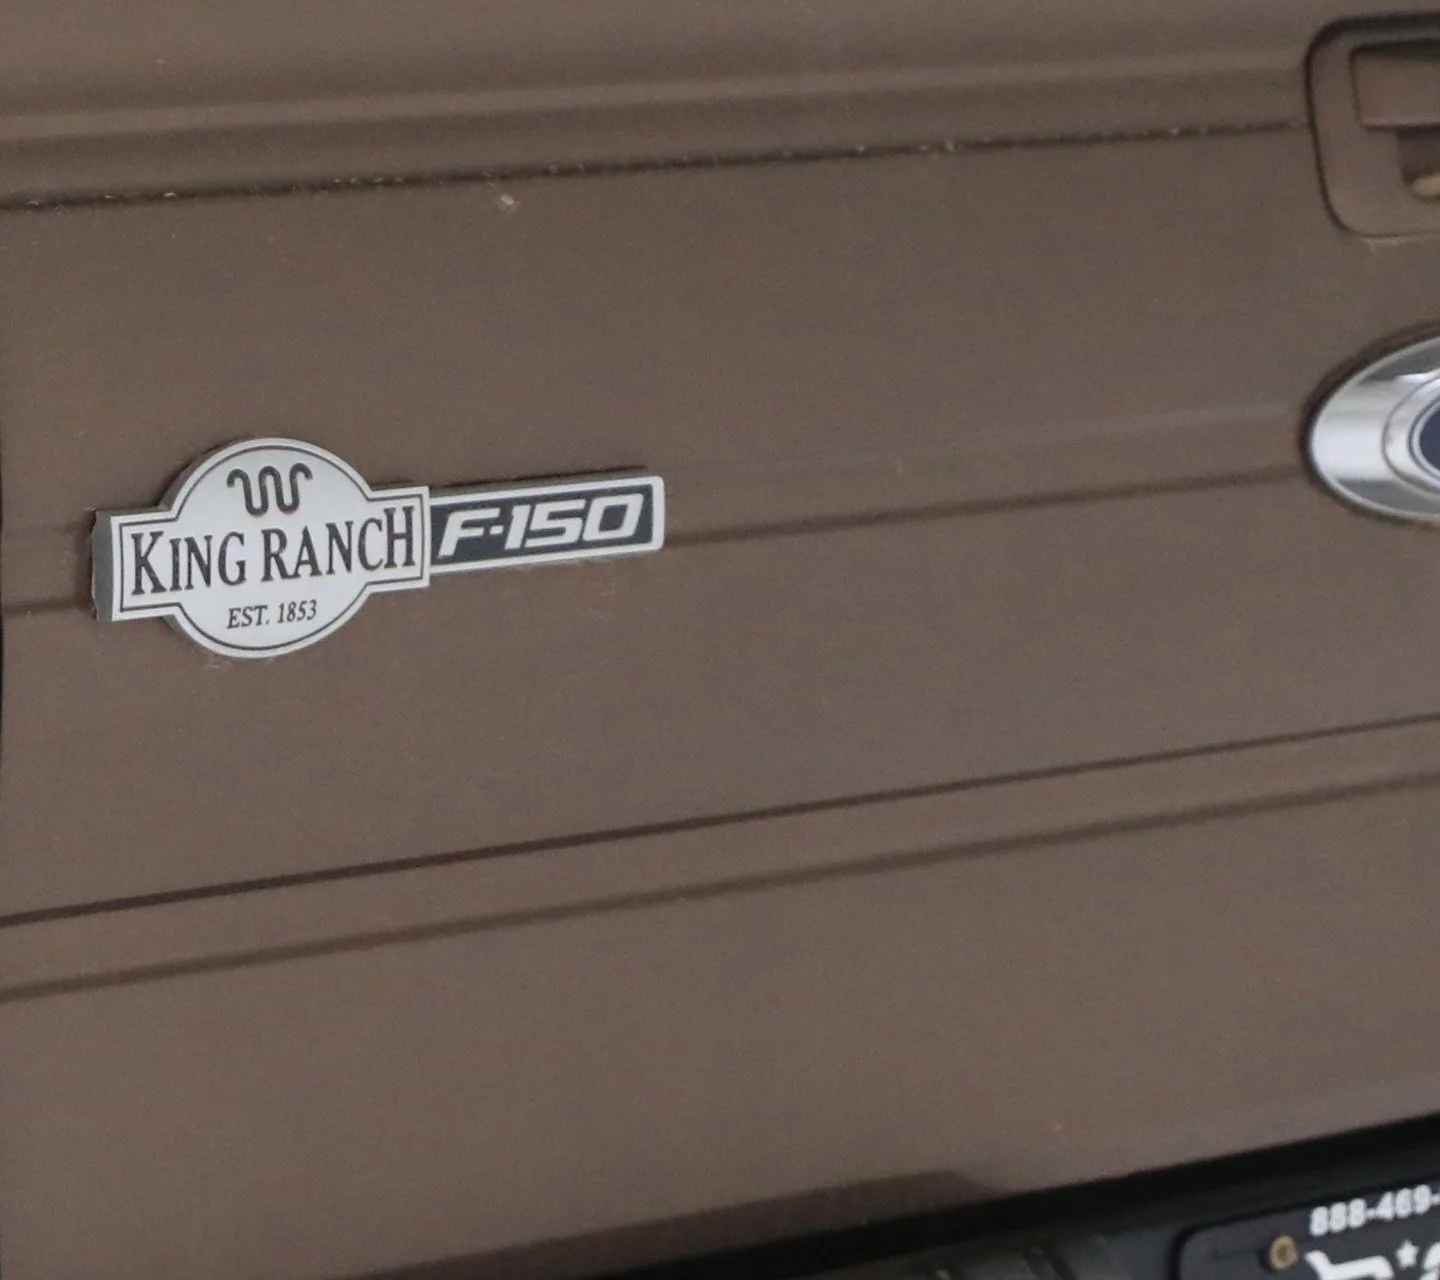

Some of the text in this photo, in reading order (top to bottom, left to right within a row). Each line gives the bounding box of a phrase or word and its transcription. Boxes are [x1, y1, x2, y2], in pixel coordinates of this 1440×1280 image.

[130, 505, 417, 597] KING RANCH
[436, 493, 645, 560] F-150
[226, 598, 318, 630] EST. 1853
